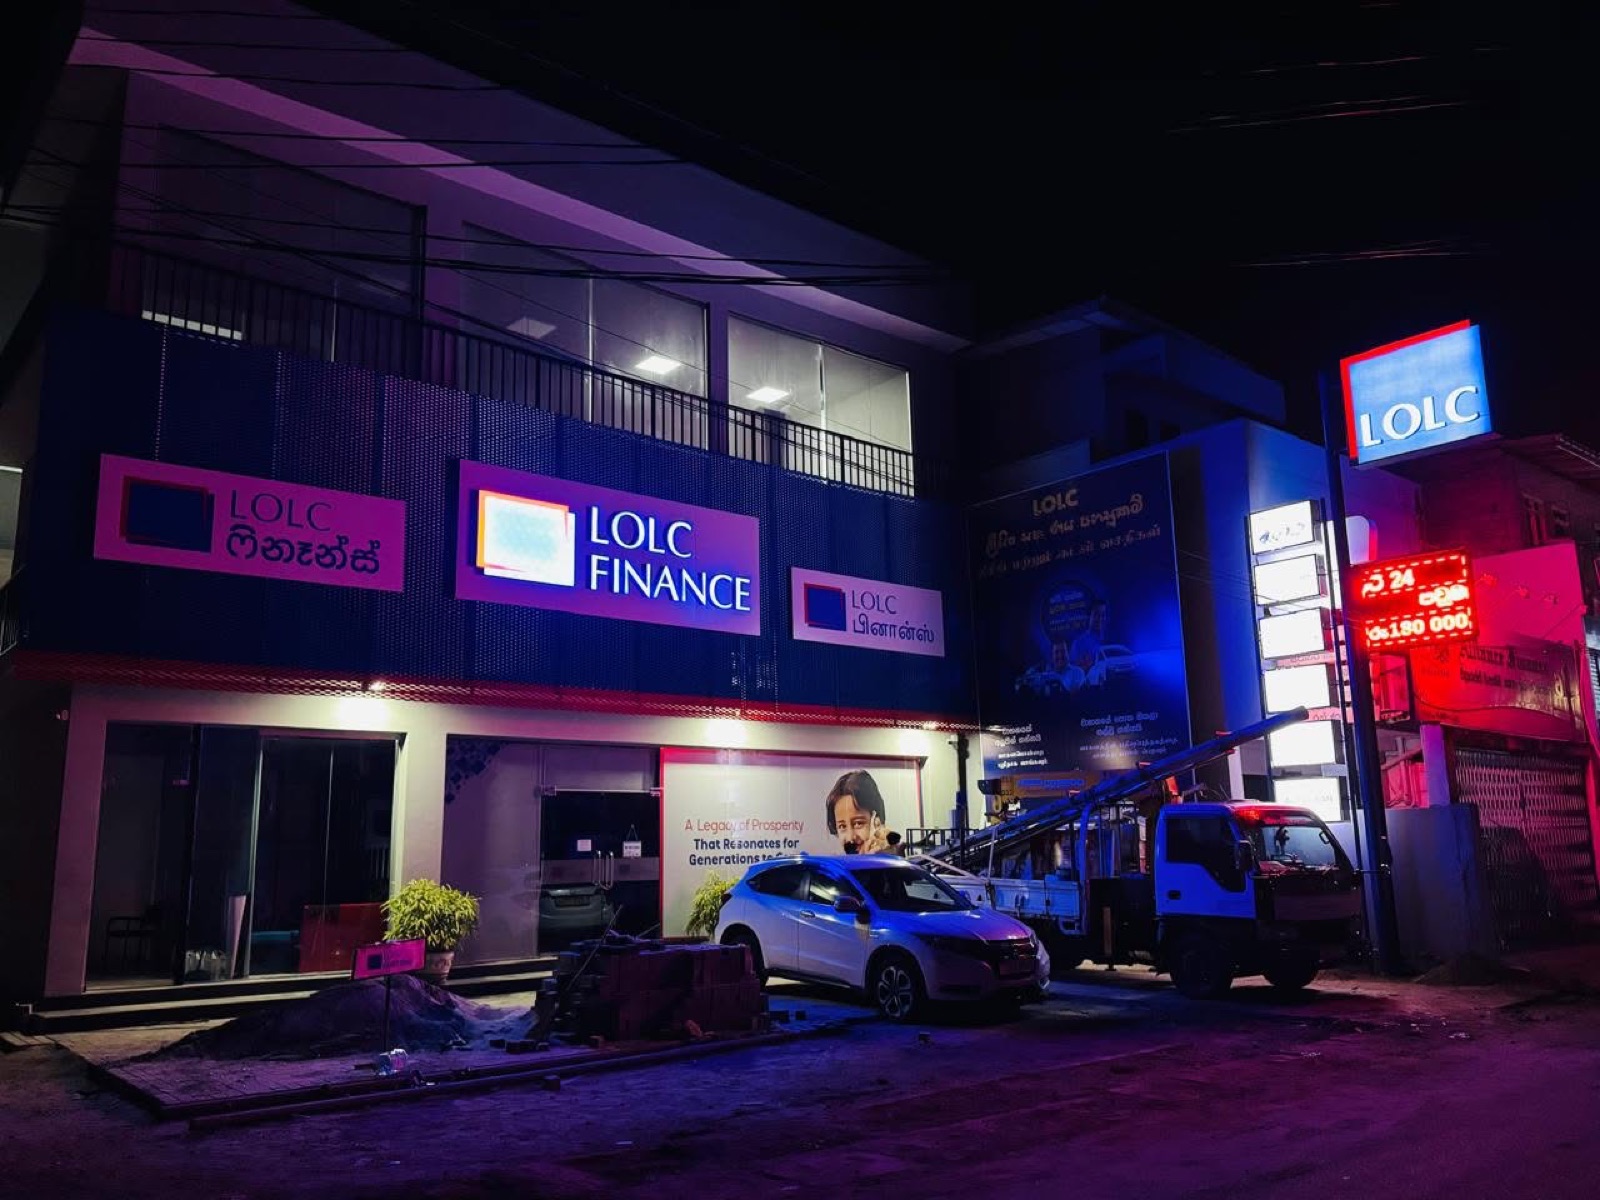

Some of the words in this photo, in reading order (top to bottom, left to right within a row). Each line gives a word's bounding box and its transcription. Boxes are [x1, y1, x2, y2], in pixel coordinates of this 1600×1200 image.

[1360, 385, 1479, 447] LOLC
[229, 489, 333, 532] LOLC
[1032, 488, 1080, 516] LOLC
[590, 506, 692, 558] LOLC
[590, 554, 751, 612] FINANCE
[1388, 568, 1416, 590] 24
[851, 589, 897, 615] LOLC
[853, 613, 936, 643] பினான்ஸ்
[684, 819, 694, 831] A
[739, 818, 751, 831] of
[752, 818, 805, 834] Prosperity
[694, 838, 721, 851] That
[723, 838, 781, 850] Resonates
[783, 837, 800, 849] for
[689, 853, 760, 866] Generations
